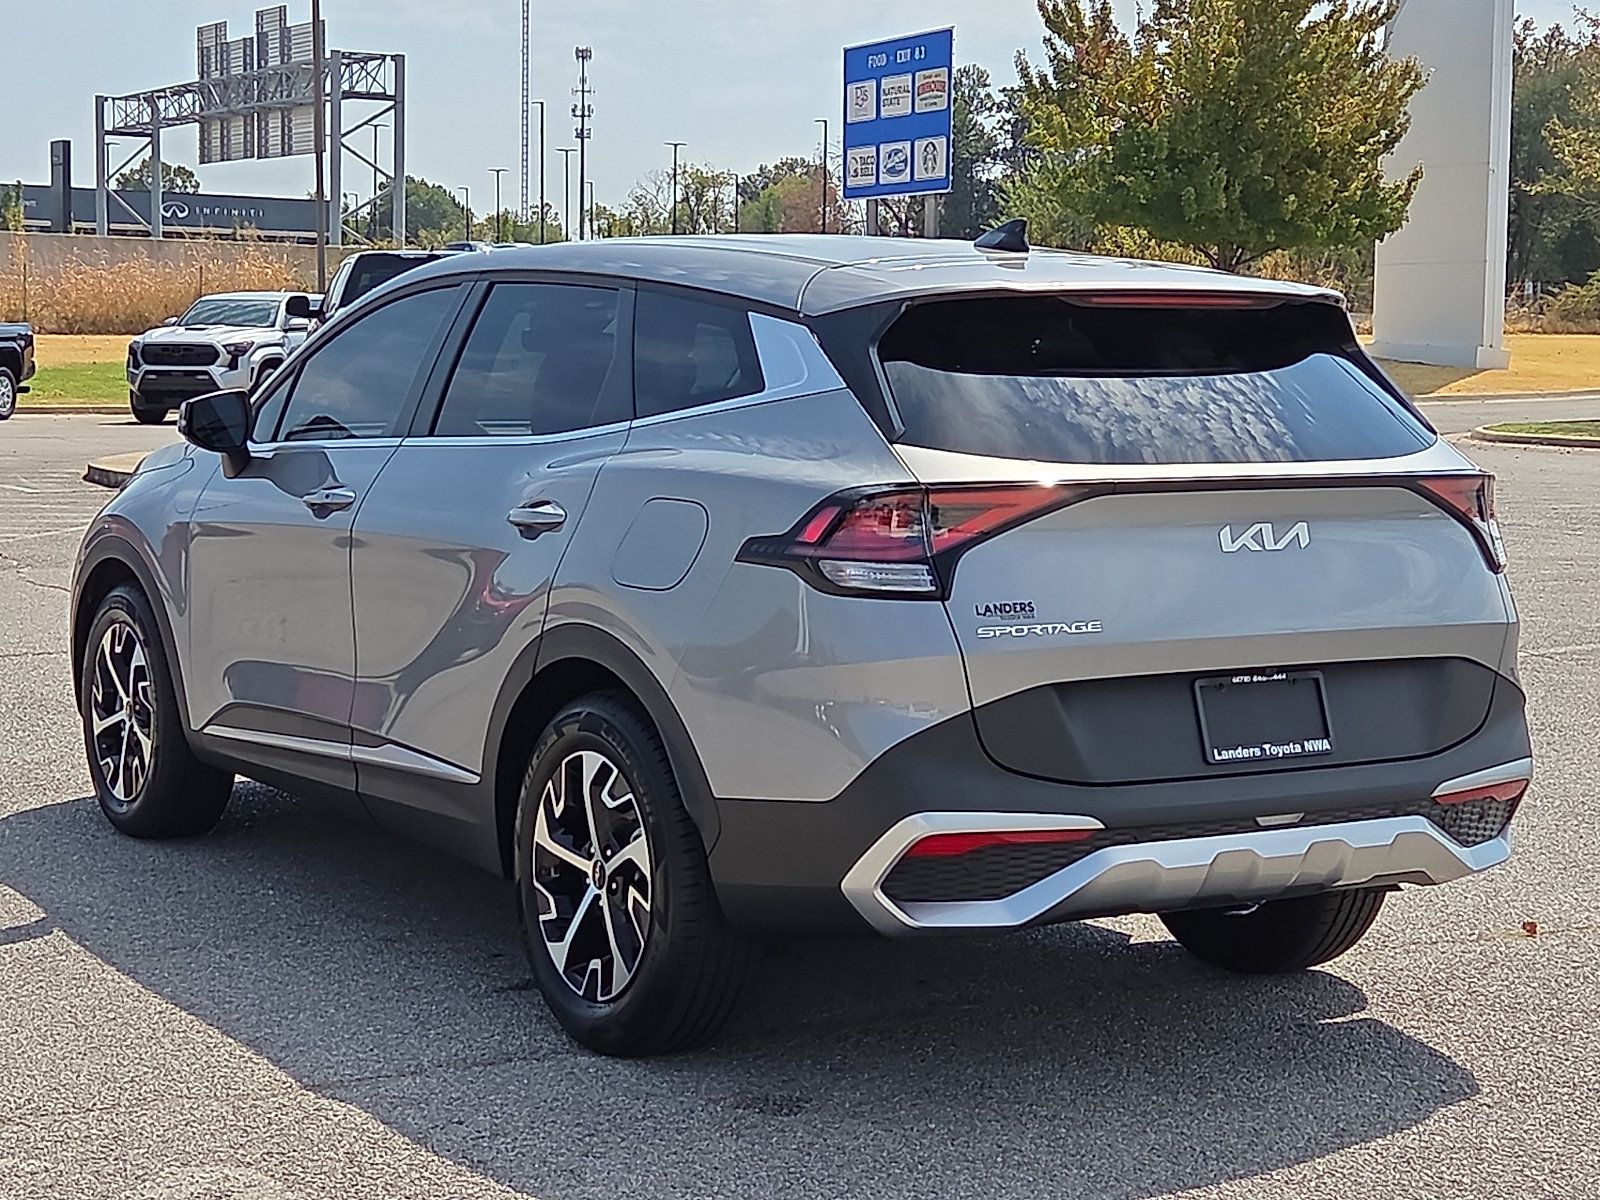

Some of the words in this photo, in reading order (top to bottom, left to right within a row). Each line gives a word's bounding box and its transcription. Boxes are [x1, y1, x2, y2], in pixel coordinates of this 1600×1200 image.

[868, 53, 888, 69] FOOD
[896, 48, 911, 63] EXIT
[882, 84, 911, 96] NATURAL
[882, 98, 901, 107] STATE
[859, 155, 875, 166] TACO
[860, 166, 874, 176] BELL
[195, 206, 264, 218] INFINITI
[1219, 521, 1311, 553] KIA
[975, 601, 1035, 616] LANDERS
[977, 620, 1103, 638] SPORTAGE
[1213, 746, 1261, 760] Landers
[1261, 742, 1302, 758] Toyota
[1304, 739, 1331, 752] NWA
